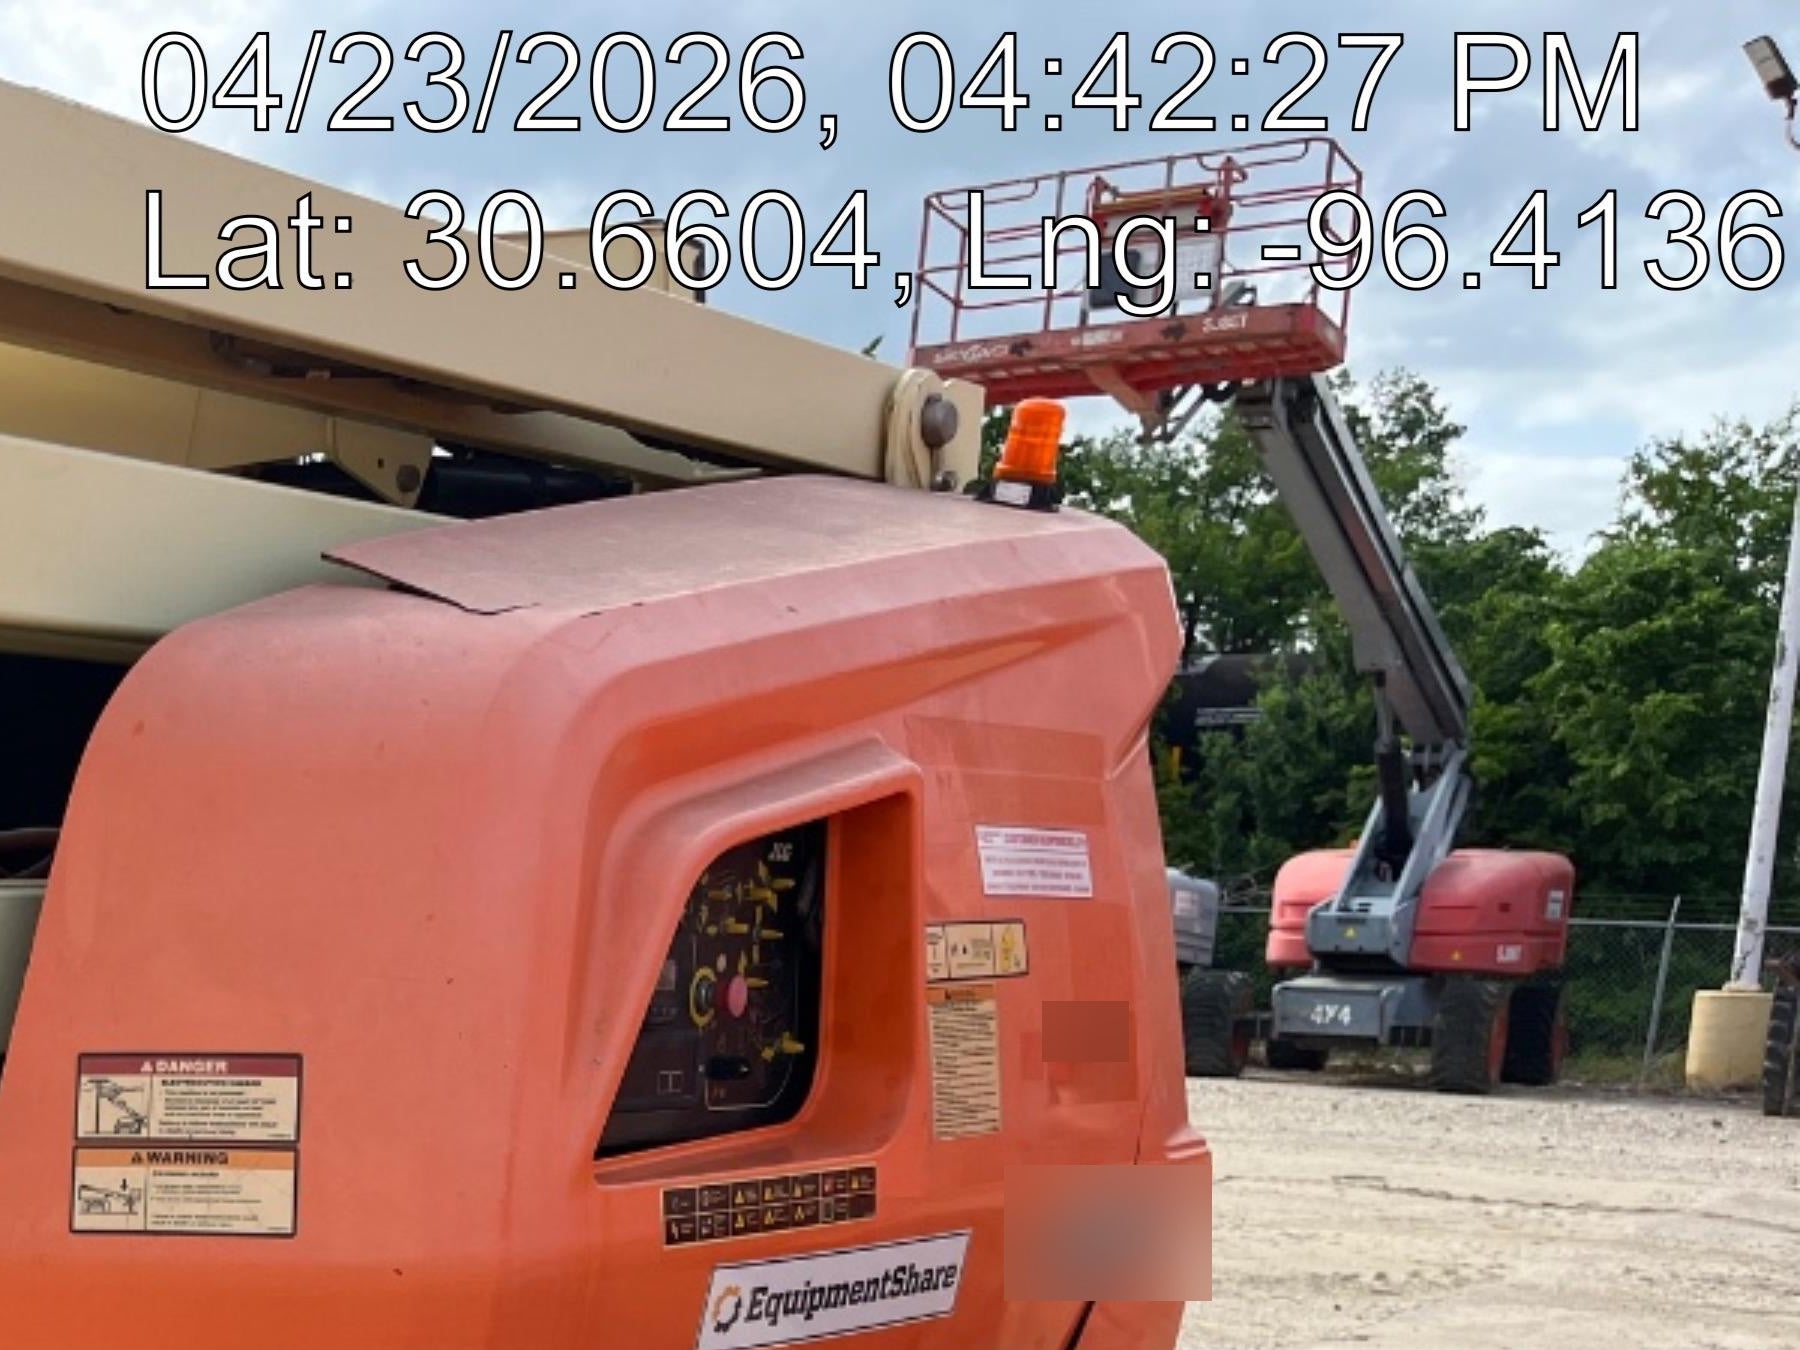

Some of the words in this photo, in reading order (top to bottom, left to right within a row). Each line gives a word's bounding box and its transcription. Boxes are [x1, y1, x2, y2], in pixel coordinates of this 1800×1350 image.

[156, 1060, 228, 1073] DANGER
[147, 1151, 229, 1165] WARNING
[744, 1261, 958, 1326] EquipmentShare
